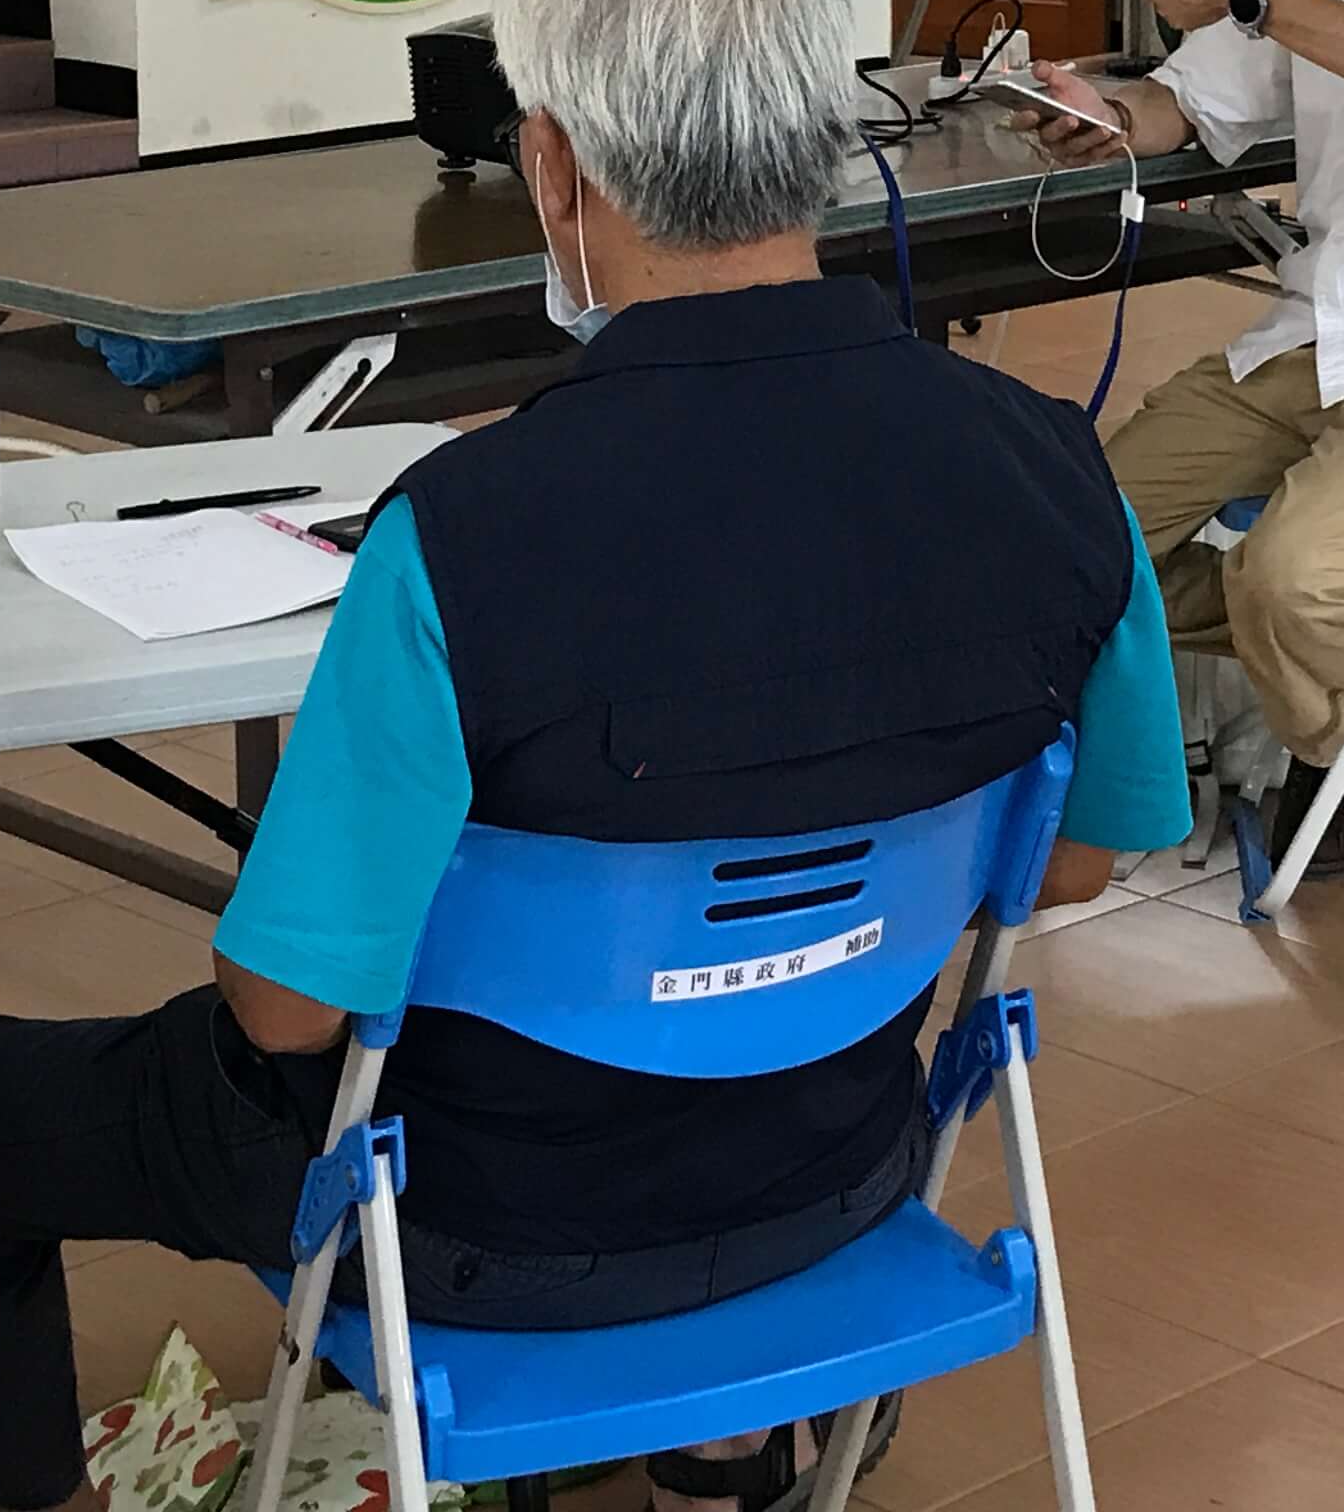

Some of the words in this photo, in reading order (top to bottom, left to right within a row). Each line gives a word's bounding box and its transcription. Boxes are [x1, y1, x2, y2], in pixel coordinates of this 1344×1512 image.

[657, 954, 806, 994] 金門縣政府
[845, 927, 880, 957] 補助
